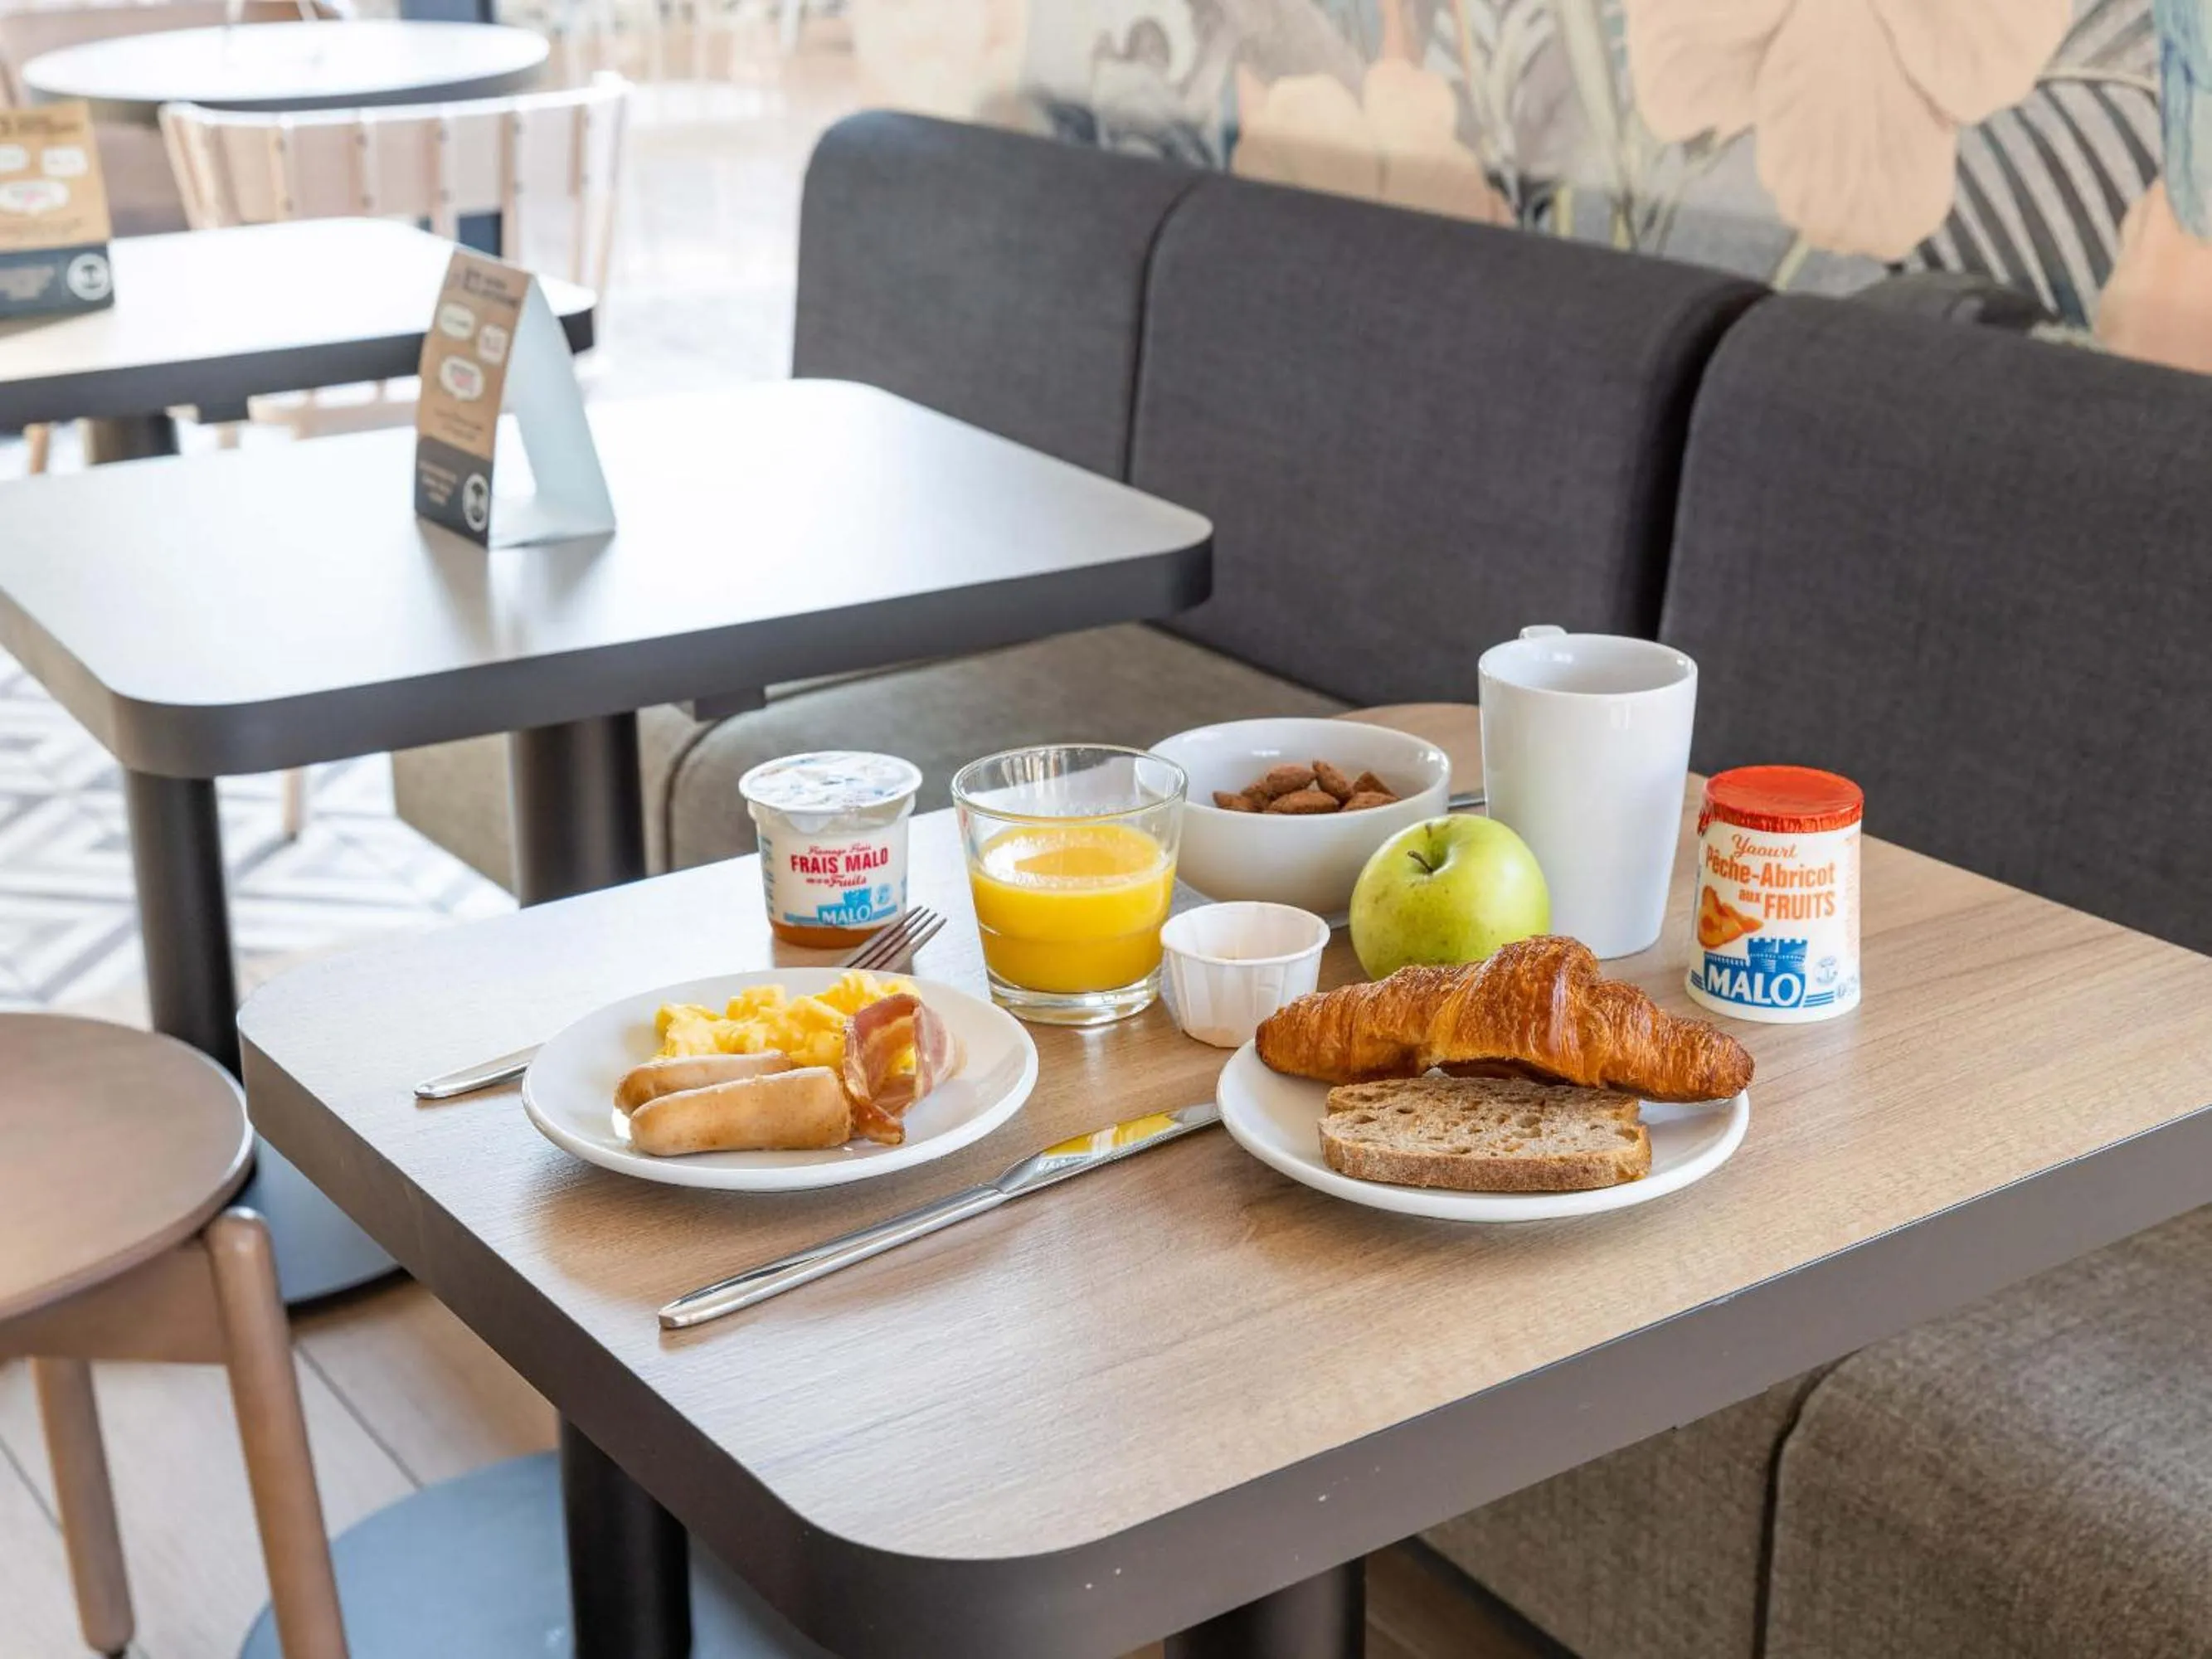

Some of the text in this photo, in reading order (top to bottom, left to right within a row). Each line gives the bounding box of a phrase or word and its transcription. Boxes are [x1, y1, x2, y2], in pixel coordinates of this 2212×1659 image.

[1732, 834, 1797, 858] Yaourt
[790, 847, 888, 873] FRAIS MALO
[829, 874, 867, 888] Fruits
[821, 904, 871, 925] MALO
[1738, 889, 1835, 919] aux FRUITS
[1707, 965, 1801, 1007] MALO
